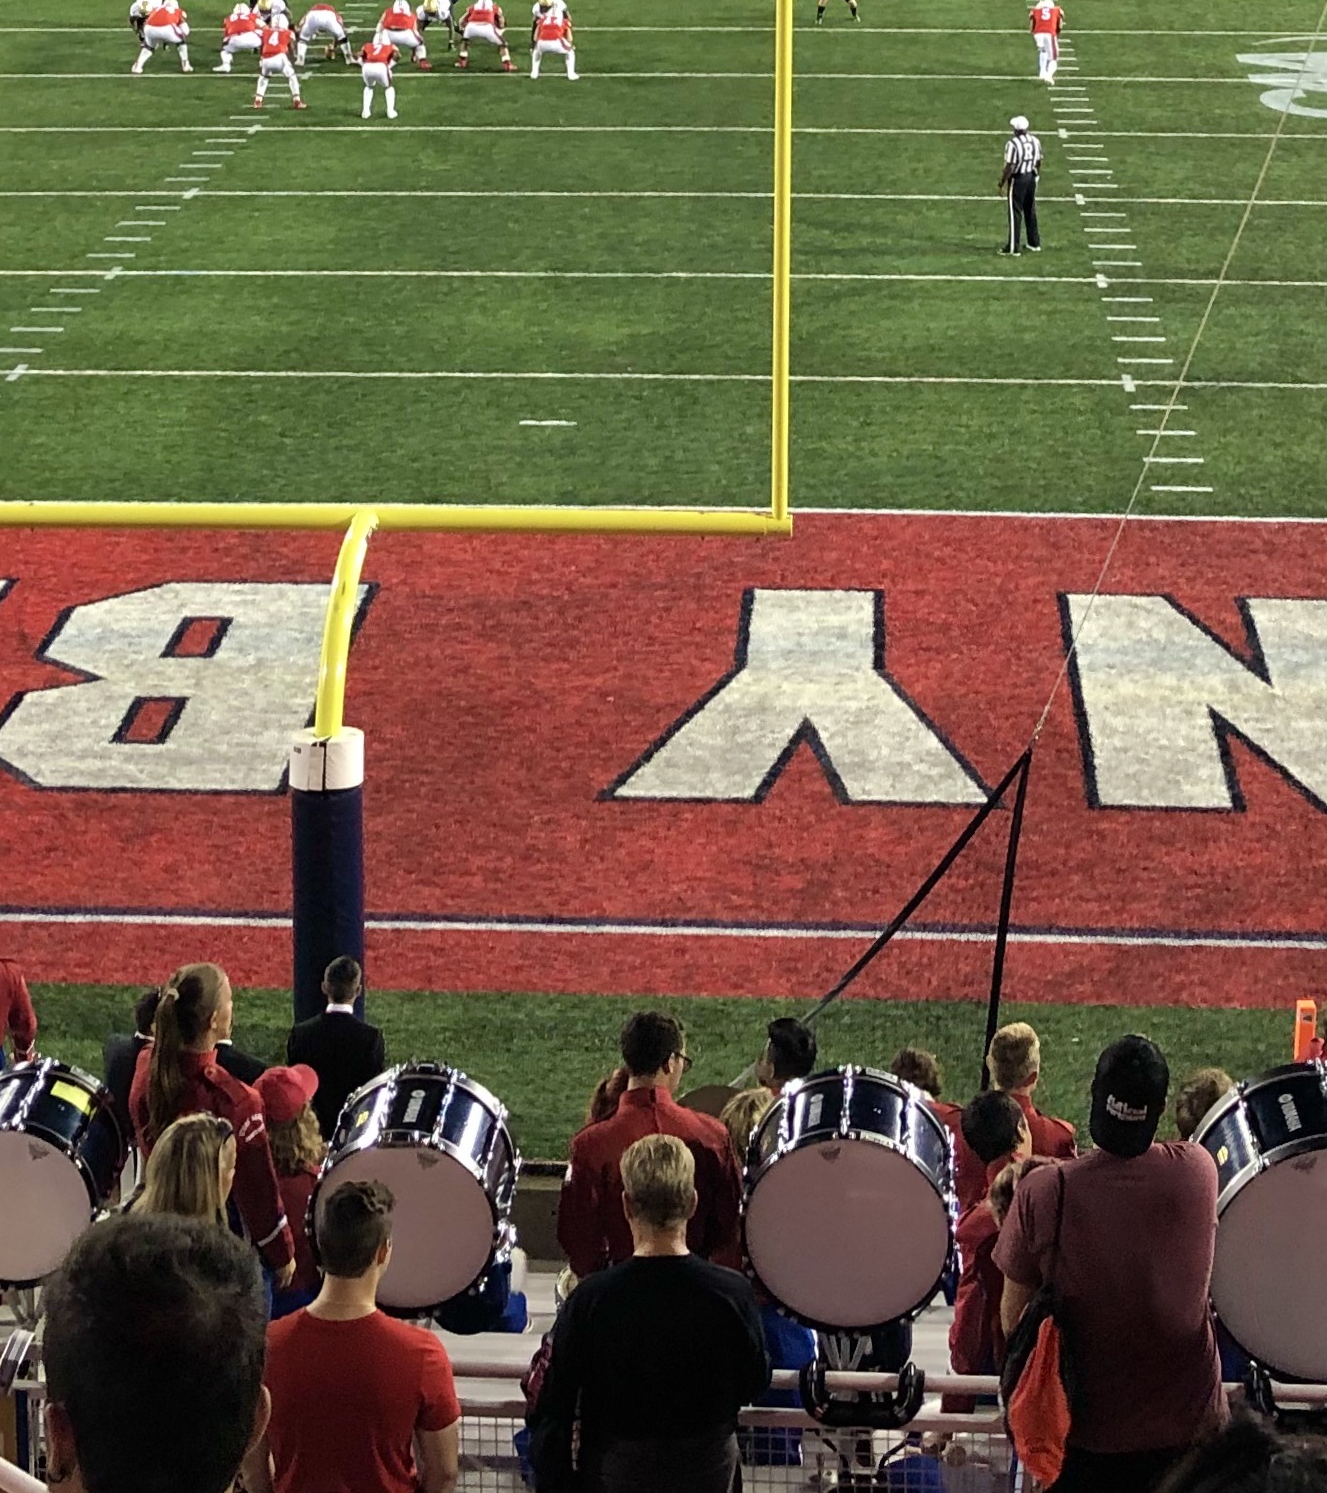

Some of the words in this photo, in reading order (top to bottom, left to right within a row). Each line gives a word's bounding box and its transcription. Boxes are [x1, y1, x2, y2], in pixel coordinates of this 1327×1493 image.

[1040, 7, 1051, 21] 5
[267, 30, 279, 47] 4
[1024, 142, 1034, 160] R
